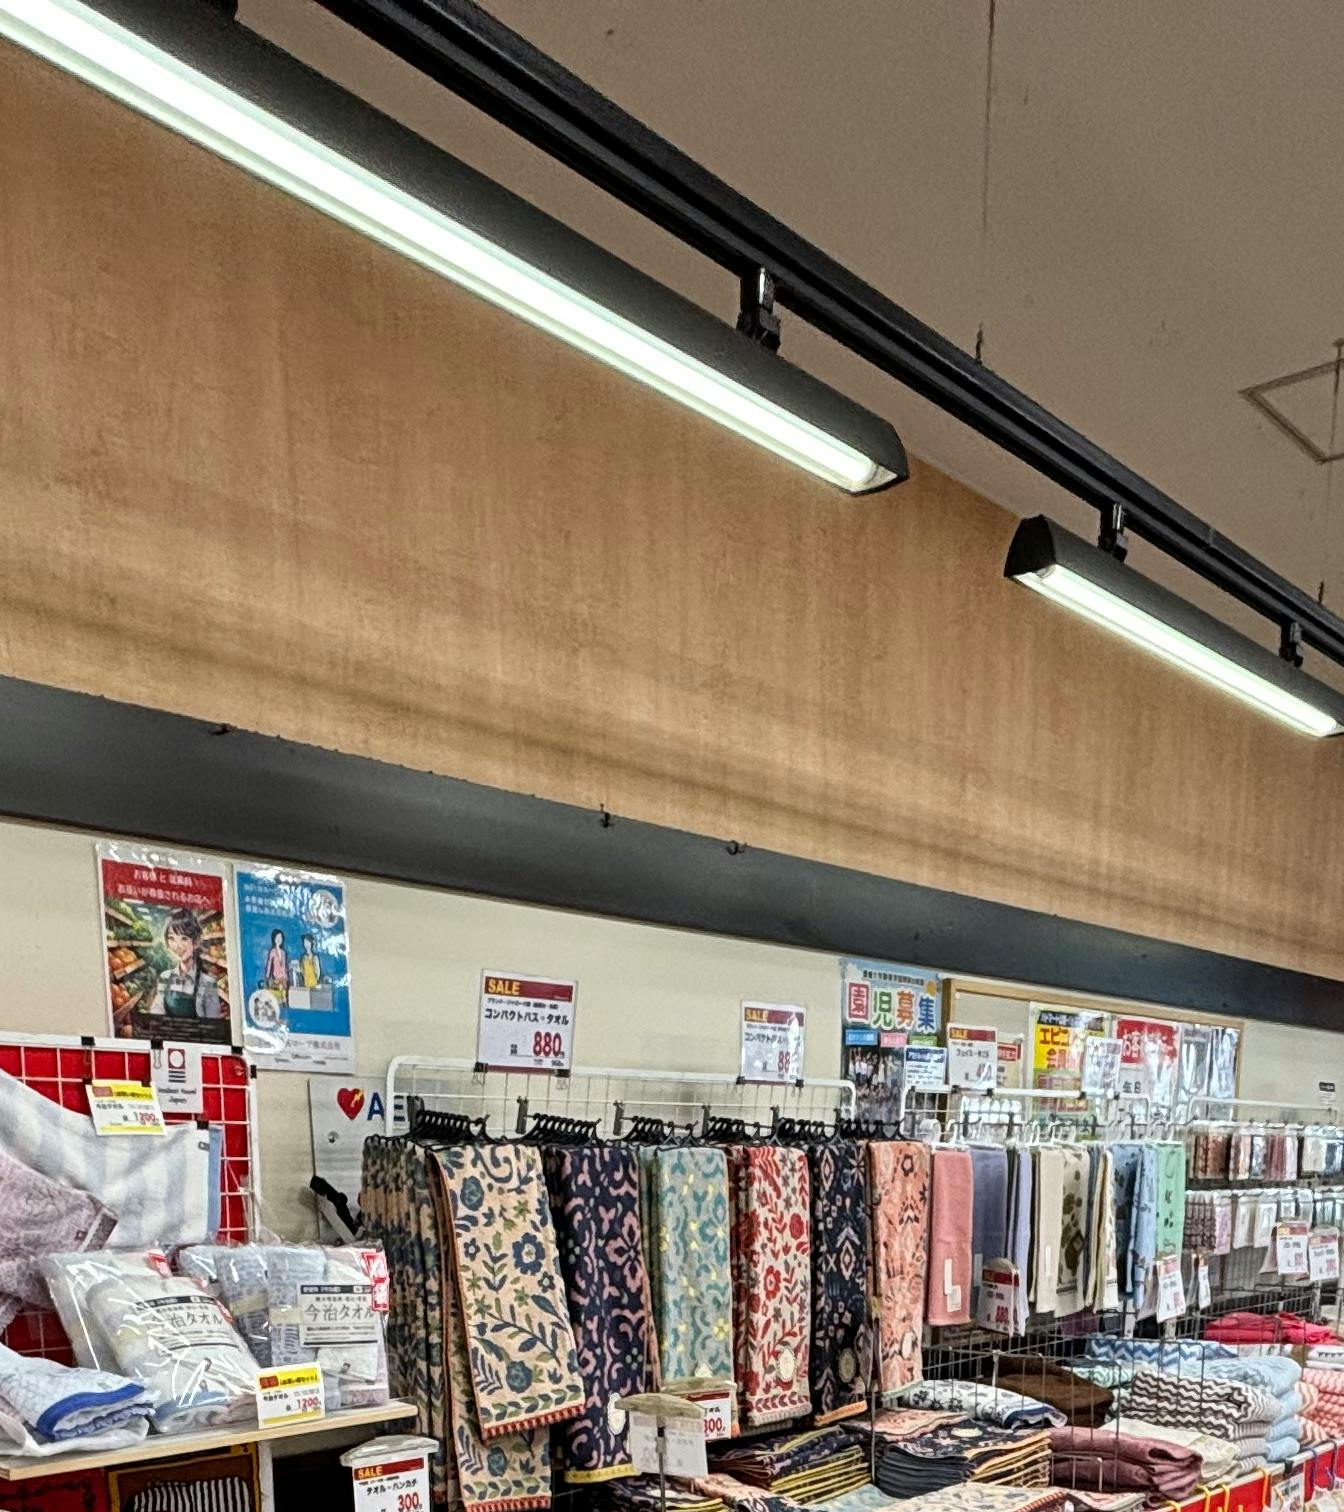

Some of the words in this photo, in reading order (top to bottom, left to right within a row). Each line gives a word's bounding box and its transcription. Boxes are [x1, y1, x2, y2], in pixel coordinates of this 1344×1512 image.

[487, 978, 521, 996] SALE
[848, 981, 936, 1033] 園児募集
[367, 1091, 407, 1122] AE
[358, 1465, 383, 1479] SALE
